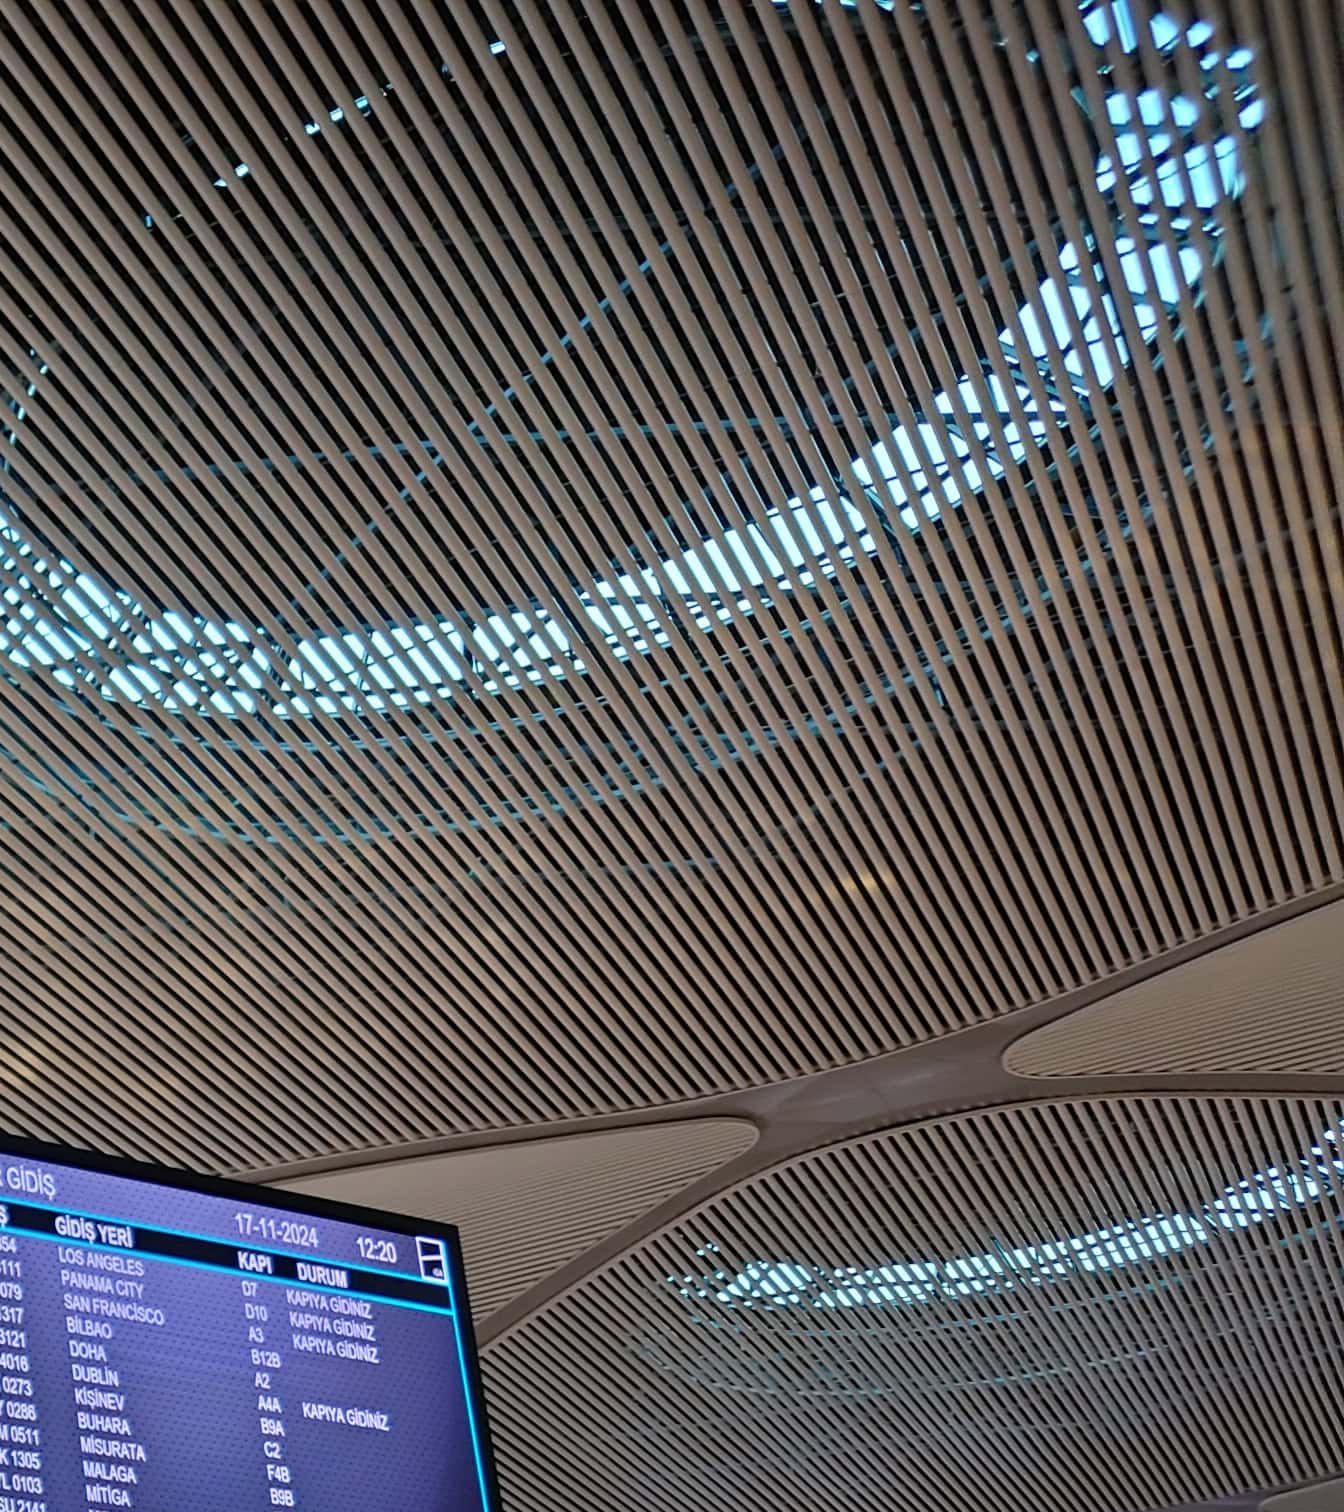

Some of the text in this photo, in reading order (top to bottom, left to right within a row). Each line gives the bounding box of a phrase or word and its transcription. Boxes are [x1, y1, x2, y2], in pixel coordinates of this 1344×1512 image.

[234, 1212, 319, 1248] 17-11-2024
[356, 1236, 397, 1263] 12:20
[237, 1250, 272, 1273] KAPI
[296, 1262, 347, 1288] DURUM
[63, 1293, 90, 1312] SAN
[292, 1333, 336, 1355] KAPIYA
